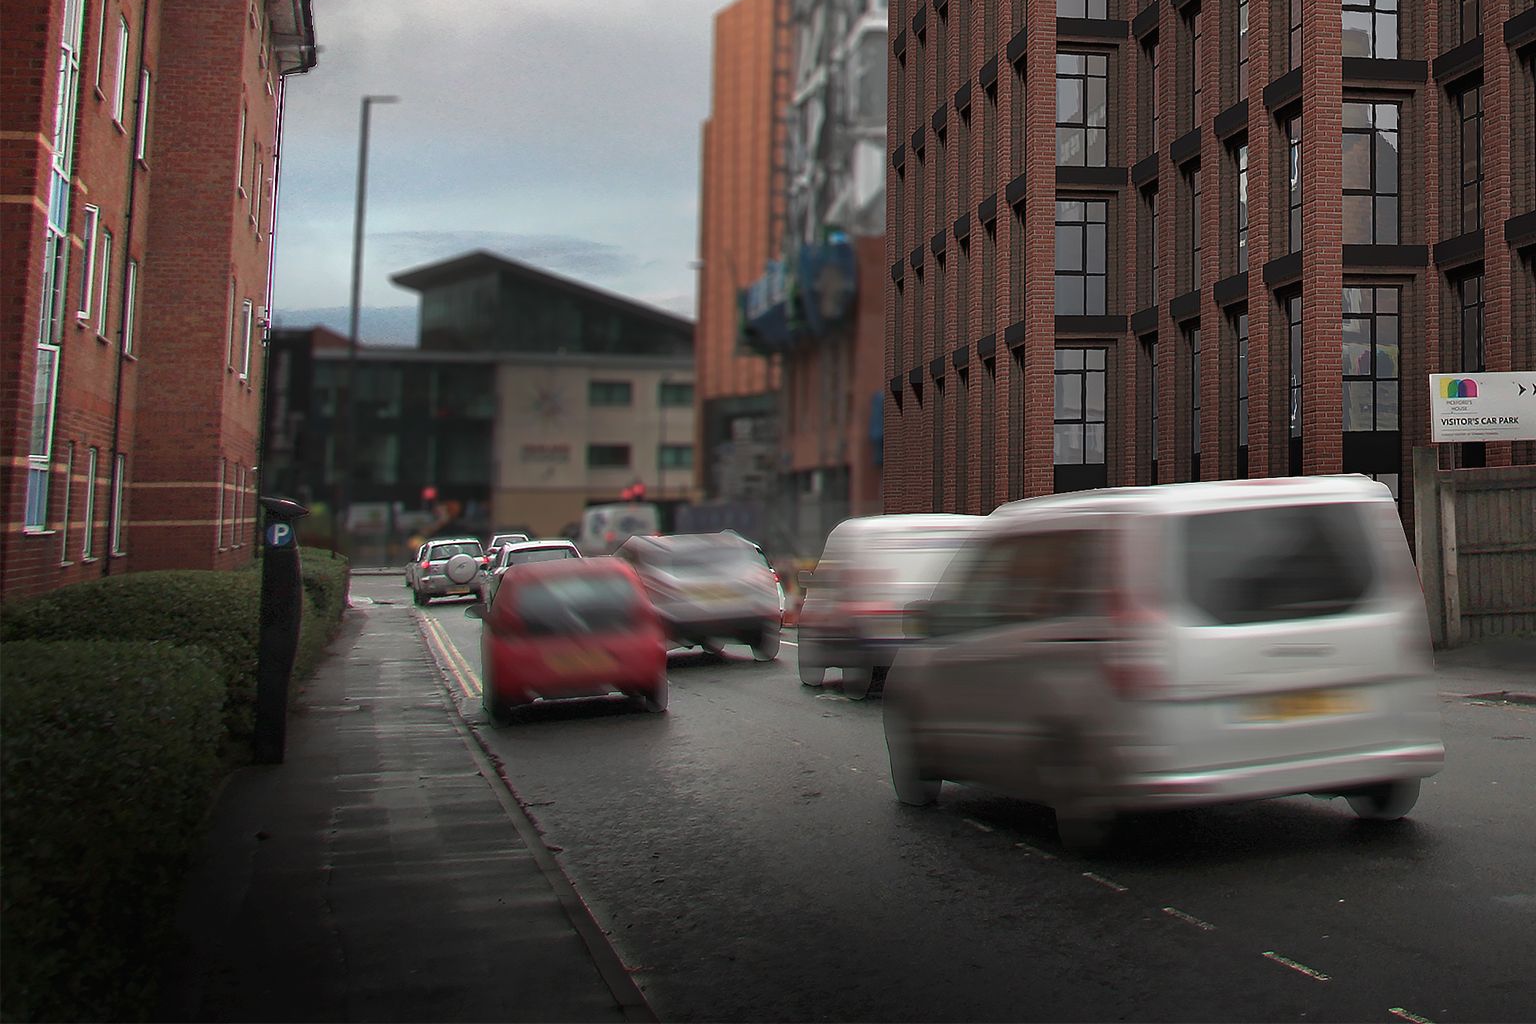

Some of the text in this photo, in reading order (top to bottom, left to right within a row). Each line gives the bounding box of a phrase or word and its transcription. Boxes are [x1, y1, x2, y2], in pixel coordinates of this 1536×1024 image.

[1441, 416, 1519, 426] VISITOR'S CAR PARK
[273, 523, 290, 545] P
